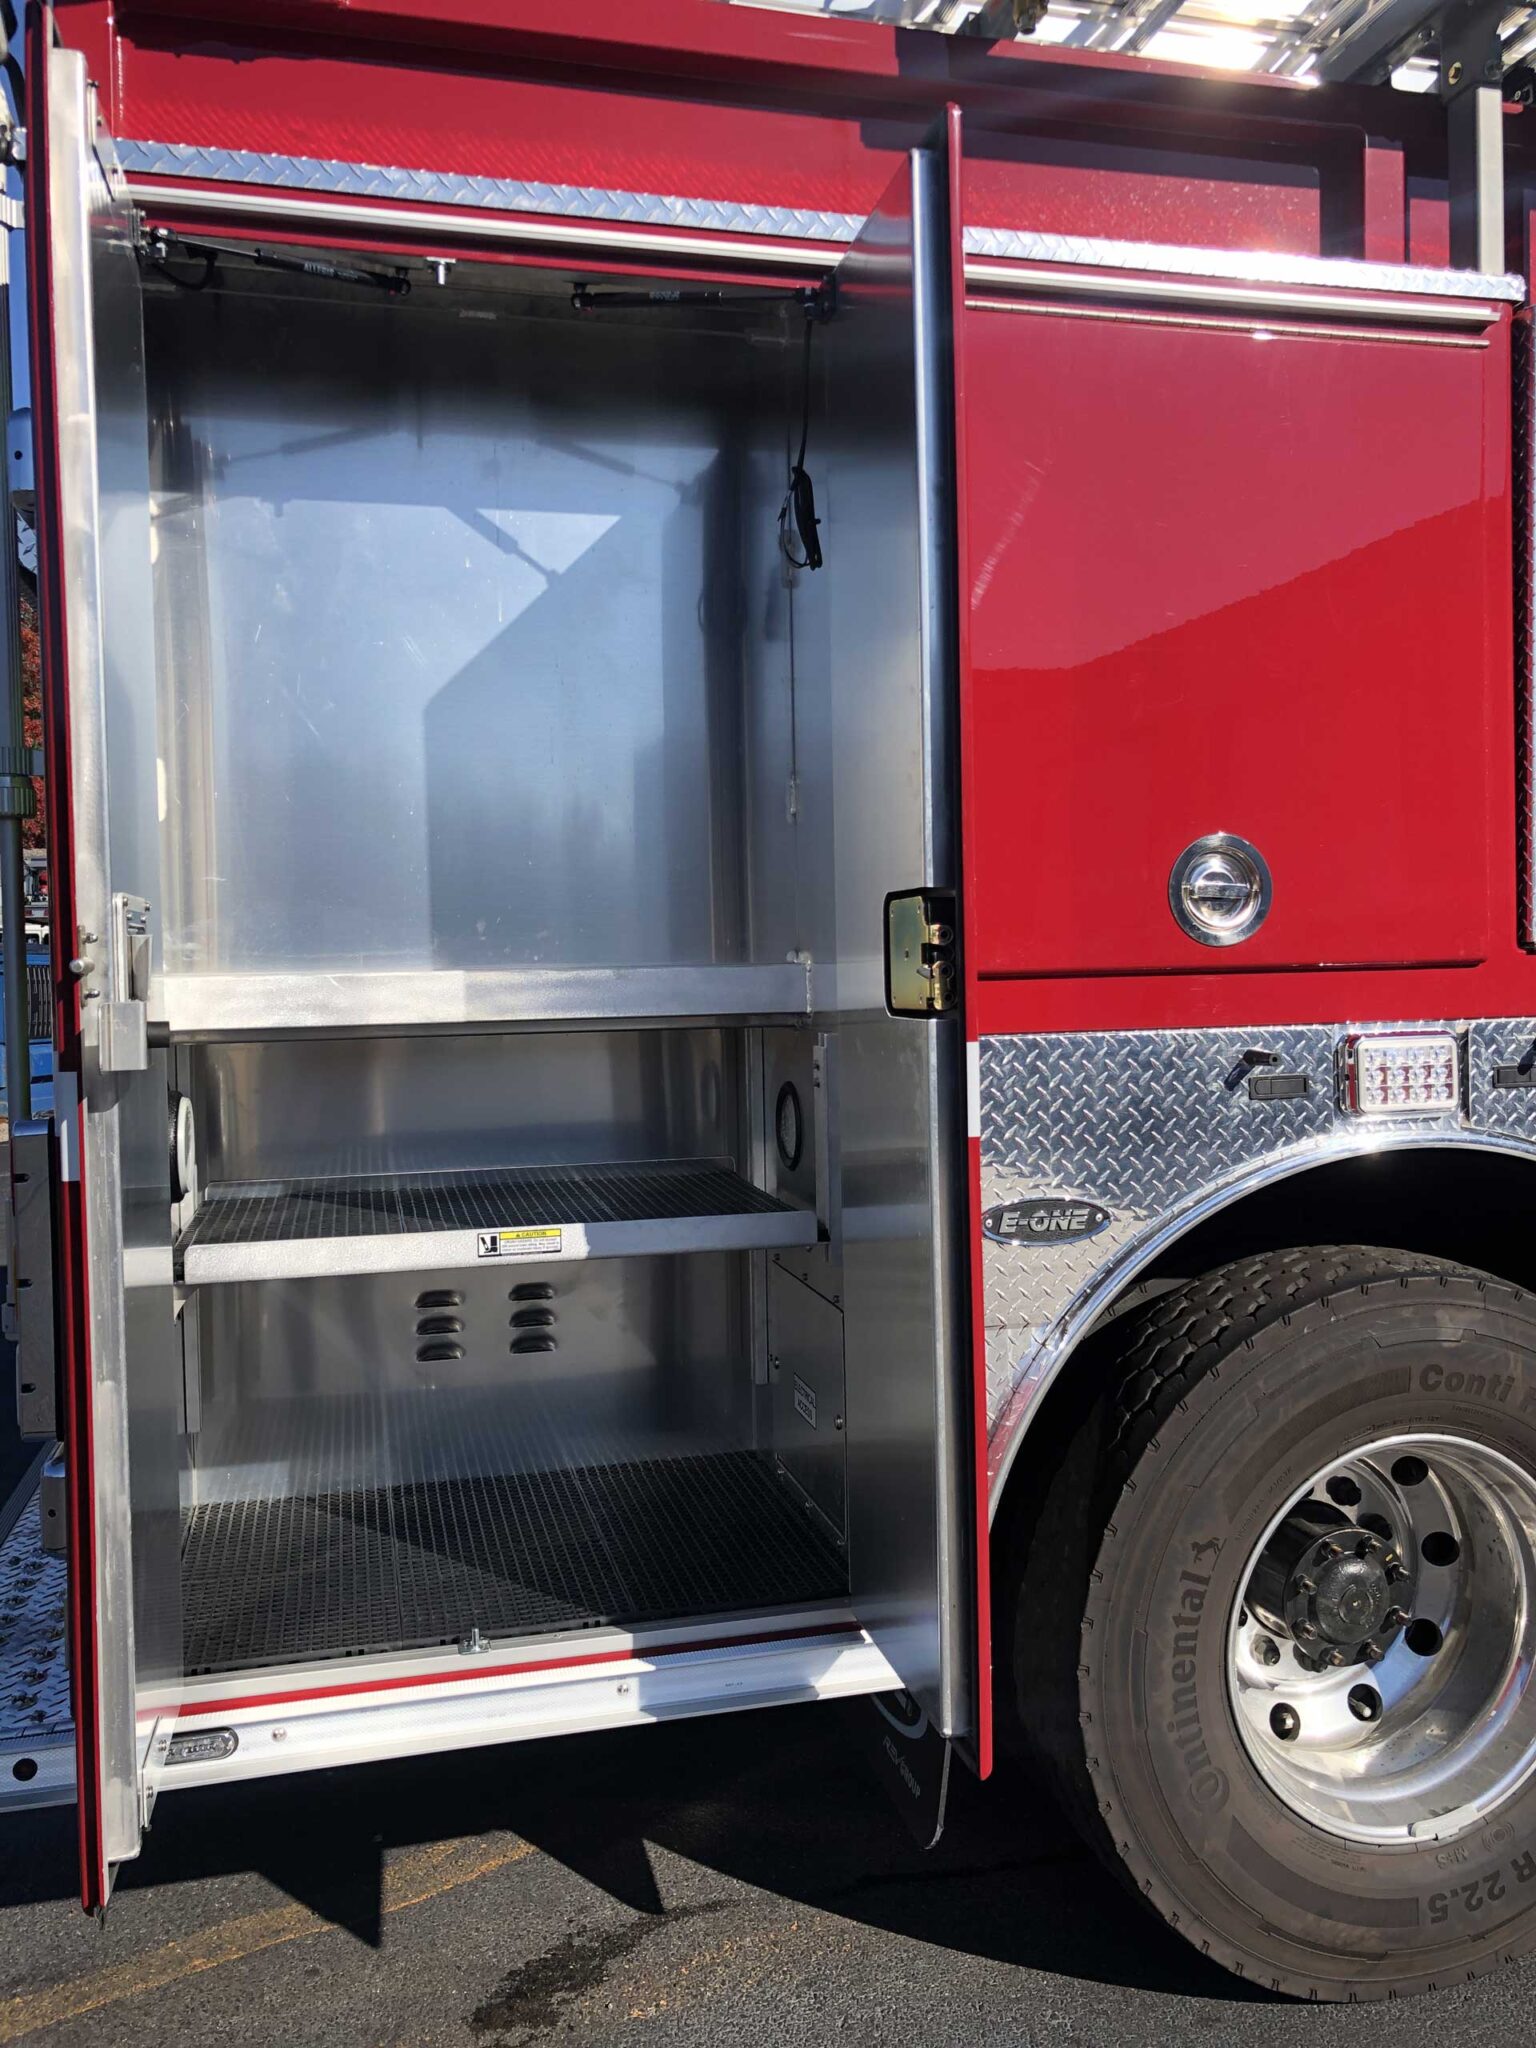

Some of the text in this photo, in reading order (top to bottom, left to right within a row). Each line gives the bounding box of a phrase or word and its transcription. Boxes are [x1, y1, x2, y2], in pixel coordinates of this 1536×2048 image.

[999, 1208, 1090, 1233] E-ONE
[1419, 1364, 1515, 1403] Conti
[1167, 1569, 1230, 1813] Continental
[1427, 1869, 1506, 1924] 22.5
